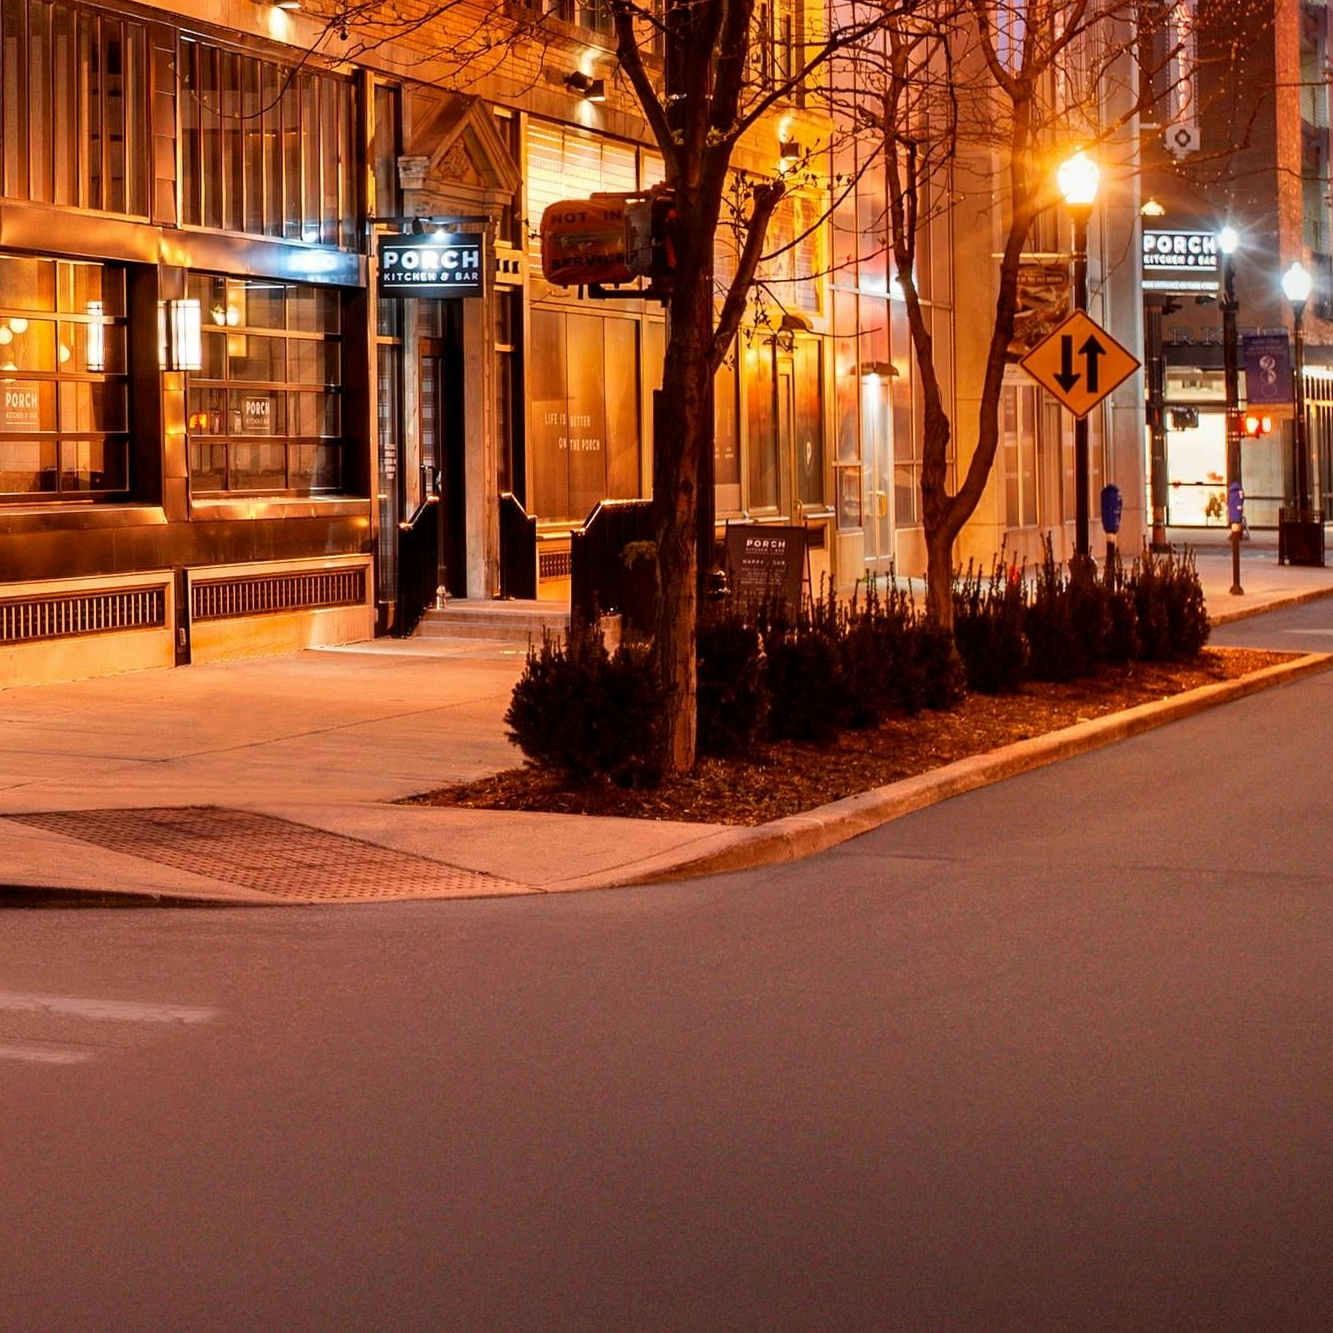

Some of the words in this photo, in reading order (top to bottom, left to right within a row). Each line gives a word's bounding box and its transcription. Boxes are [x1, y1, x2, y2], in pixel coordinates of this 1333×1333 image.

[551, 212, 588, 225] NOT
[603, 209, 623, 221] IN
[1143, 235, 1217, 255] PORCH
[383, 250, 479, 270] PORCH
[383, 272, 437, 282] KITCHEN
[440, 272, 449, 282] &
[455, 272, 479, 282] BAR
[5, 392, 38, 408] PORCH
[245, 401, 270, 416] PORCH
[544, 412, 558, 426] LIFE
[559, 413, 566, 426] IS
[558, 437, 567, 449] ON
[569, 439, 581, 451] THE
[581, 438, 601, 451] PORCH
[746, 539, 786, 549] PORCH
